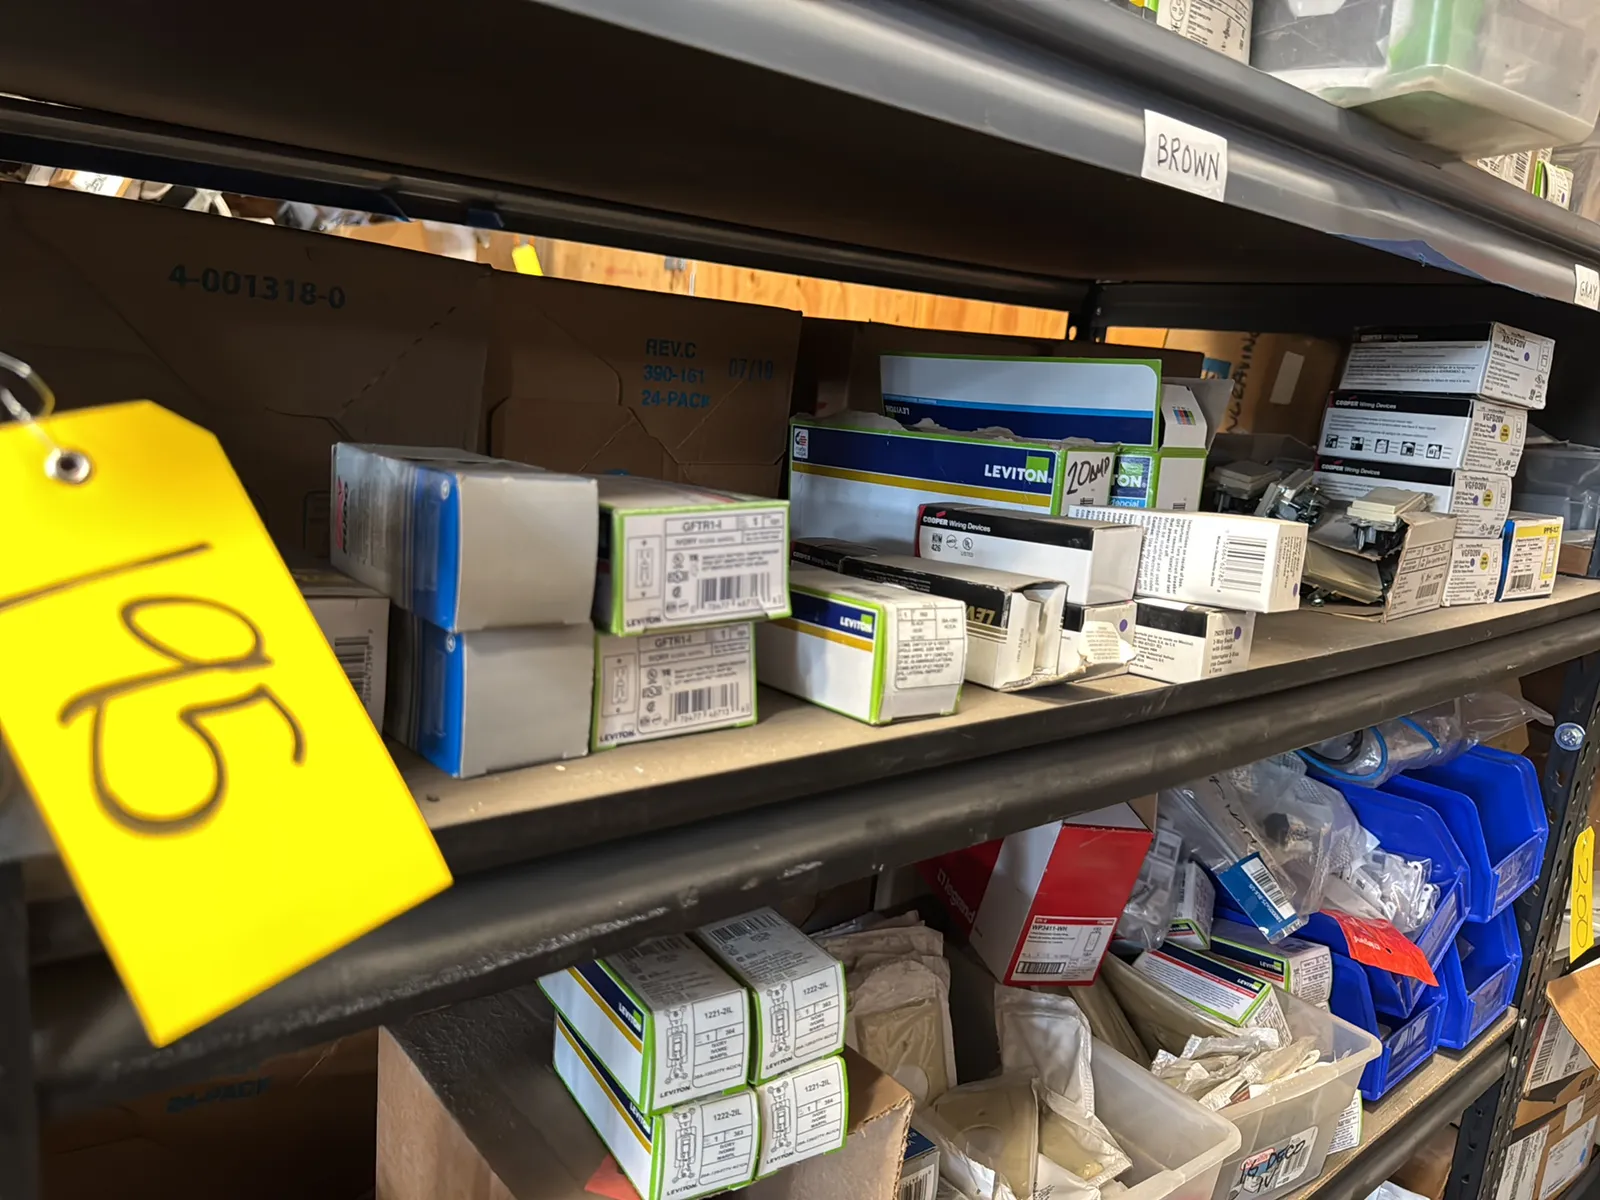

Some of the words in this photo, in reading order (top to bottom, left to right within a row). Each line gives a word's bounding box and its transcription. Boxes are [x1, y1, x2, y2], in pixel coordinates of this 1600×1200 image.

[1158, 133, 1220, 181] BROWN
[168, 263, 346, 310] 4-001318-0
[1580, 280, 1598, 302] GRAY
[646, 339, 696, 359] REV.C
[644, 364, 704, 384] 390-161
[984, 464, 1048, 483] LEVITON
[1360, 467, 1380, 476] Devices
[682, 520, 722, 532] GFTR1-I
[923, 515, 948, 526] COOPER
[949, 519, 967, 531] Wiring
[968, 522, 991, 533] Devices
[626, 615, 662, 628] LEVITON
[840, 616, 873, 633] LEVITON
[0, 542, 307, 838] 195
[600, 730, 636, 743] LEVITON
[1575, 858, 1588, 949] 200
[803, 982, 829, 996] 1222-2IL
[618, 1003, 642, 1032] LEVITON
[704, 1007, 734, 1019] 1221-2IL
[766, 1056, 793, 1070] LEVITON
[660, 1085, 691, 1098] LEVITON
[805, 1079, 832, 1093] 1221-2IL
[713, 1109, 742, 1121] 1222-2IL
[766, 1151, 795, 1165] LEVITON
[666, 1183, 698, 1196] LEVITON
